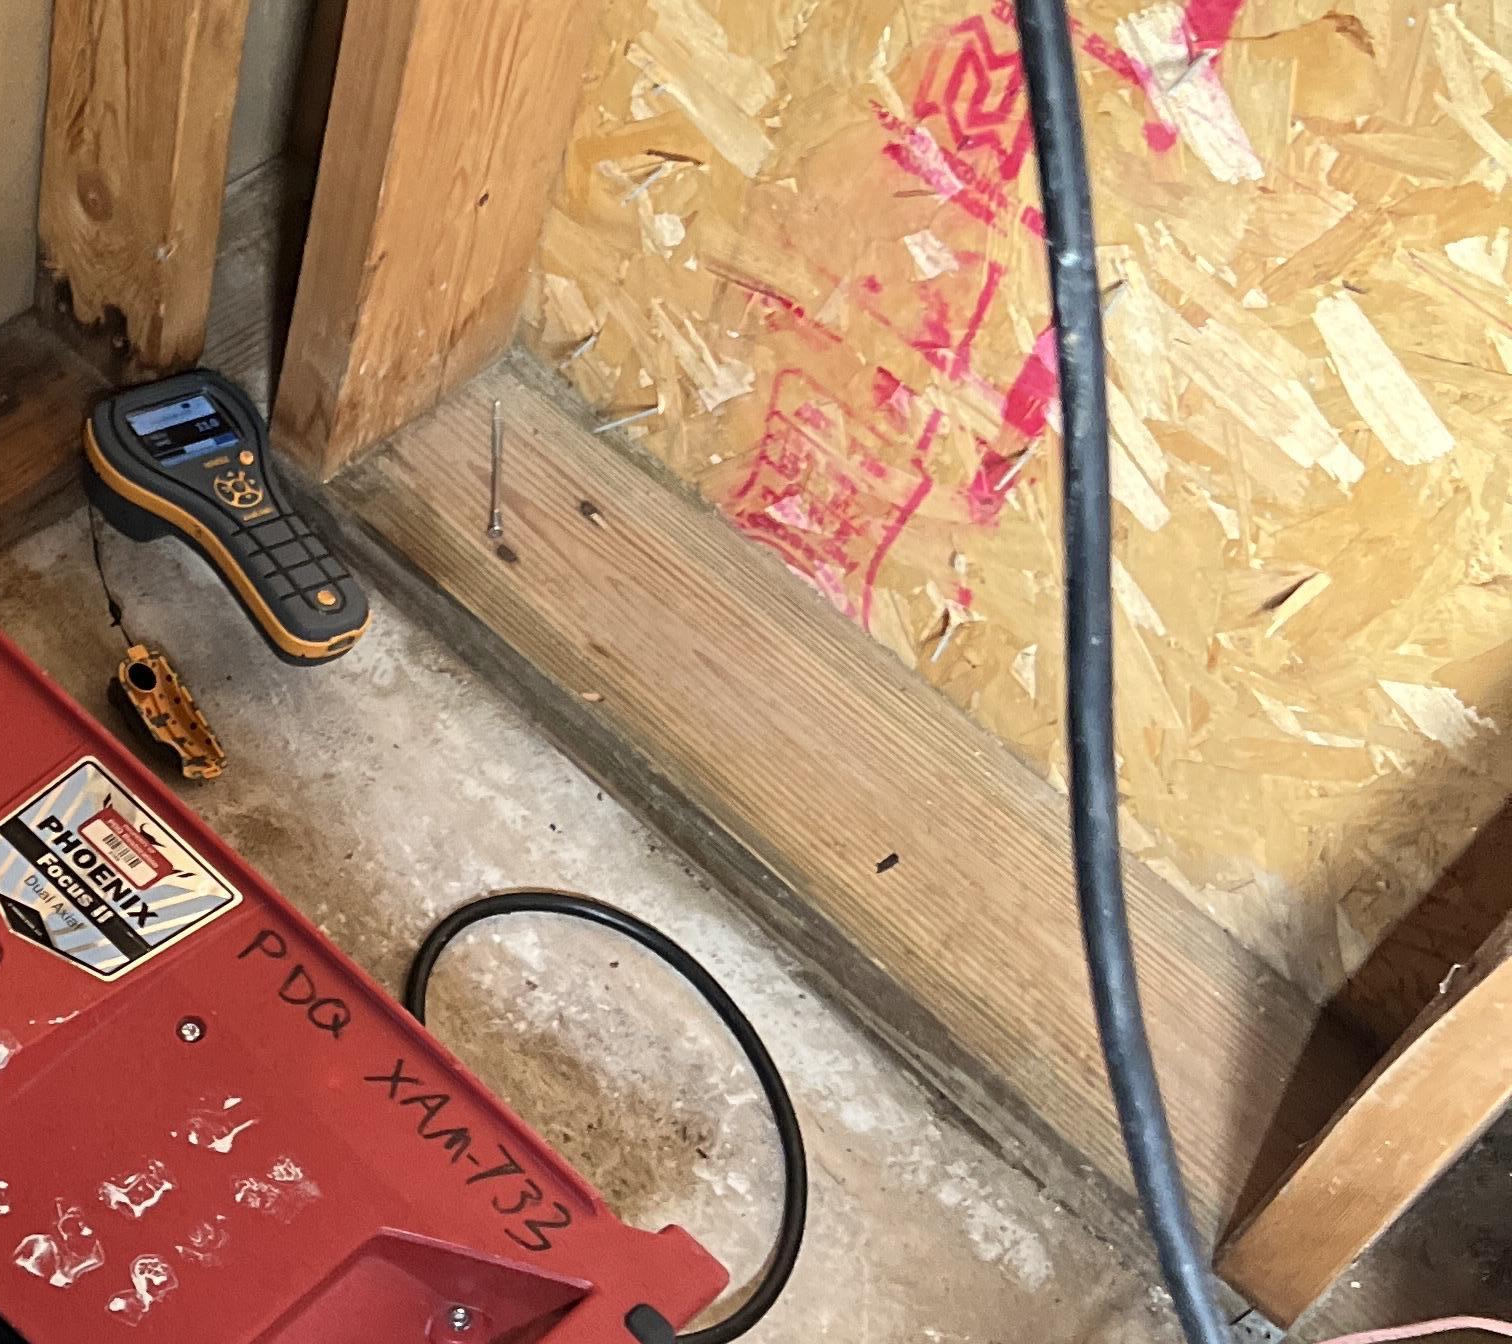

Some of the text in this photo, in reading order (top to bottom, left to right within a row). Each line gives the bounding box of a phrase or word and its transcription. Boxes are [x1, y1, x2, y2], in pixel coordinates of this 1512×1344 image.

[23, 873, 53, 904] Dual
[51, 902, 85, 930] Axial
[36, 852, 95, 908] Focus
[37, 814, 159, 929] PHOENIX
[237, 928, 352, 1040] PDQ
